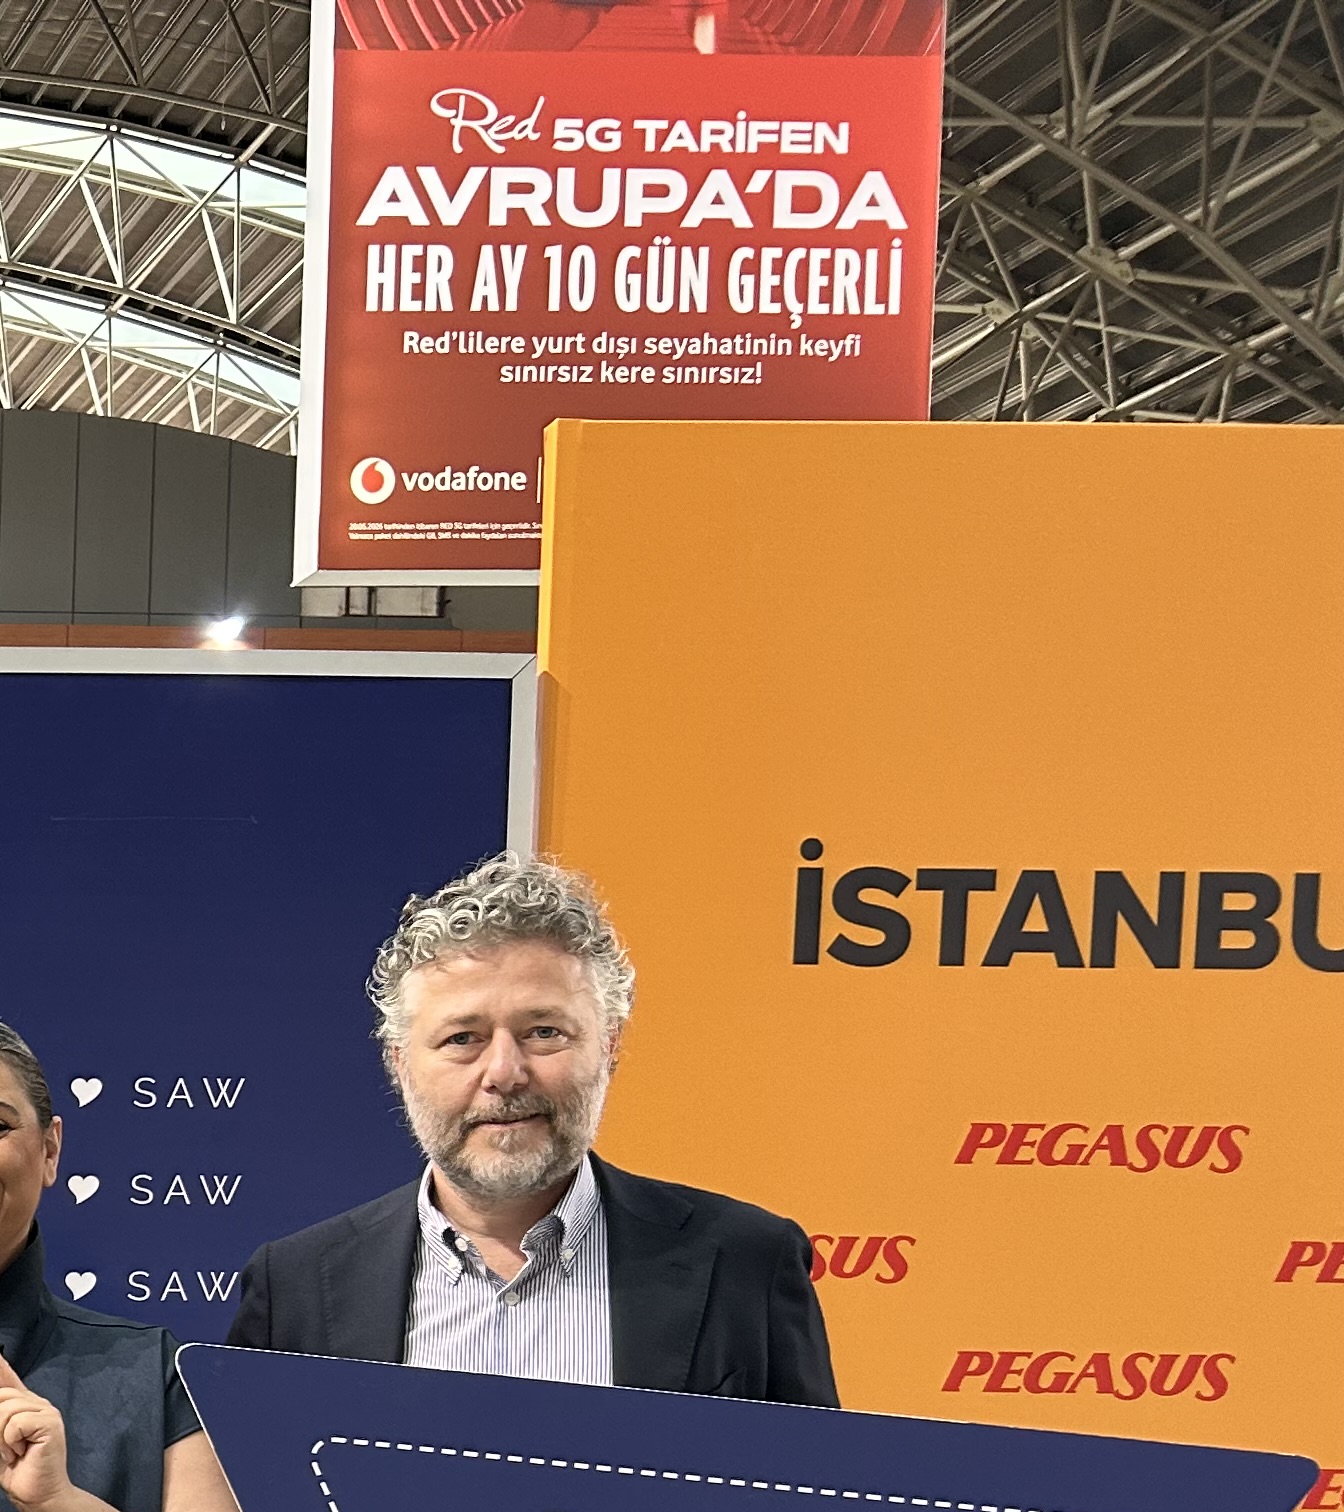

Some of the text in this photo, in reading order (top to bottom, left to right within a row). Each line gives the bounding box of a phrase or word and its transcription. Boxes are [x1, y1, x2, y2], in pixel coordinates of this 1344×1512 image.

[431, 88, 849, 154] Red 5G TARİFEN
[366, 236, 902, 328] HER AY 10 GÜN GEÇERLİ
[532, 333, 585, 358] yurt
[592, 332, 636, 359] dışı
[644, 333, 792, 360] seyahatinin
[800, 334, 861, 361] keyfi
[500, 362, 761, 384] sınırsız kere sınırsız!
[401, 466, 526, 491] vodafone
[134, 1078, 245, 1108] SAW
[954, 1123, 1250, 1173] PEGASUS
[130, 1175, 241, 1204] SAW
[128, 1271, 238, 1301] SAW
[942, 1351, 1236, 1401] PEGASUS
